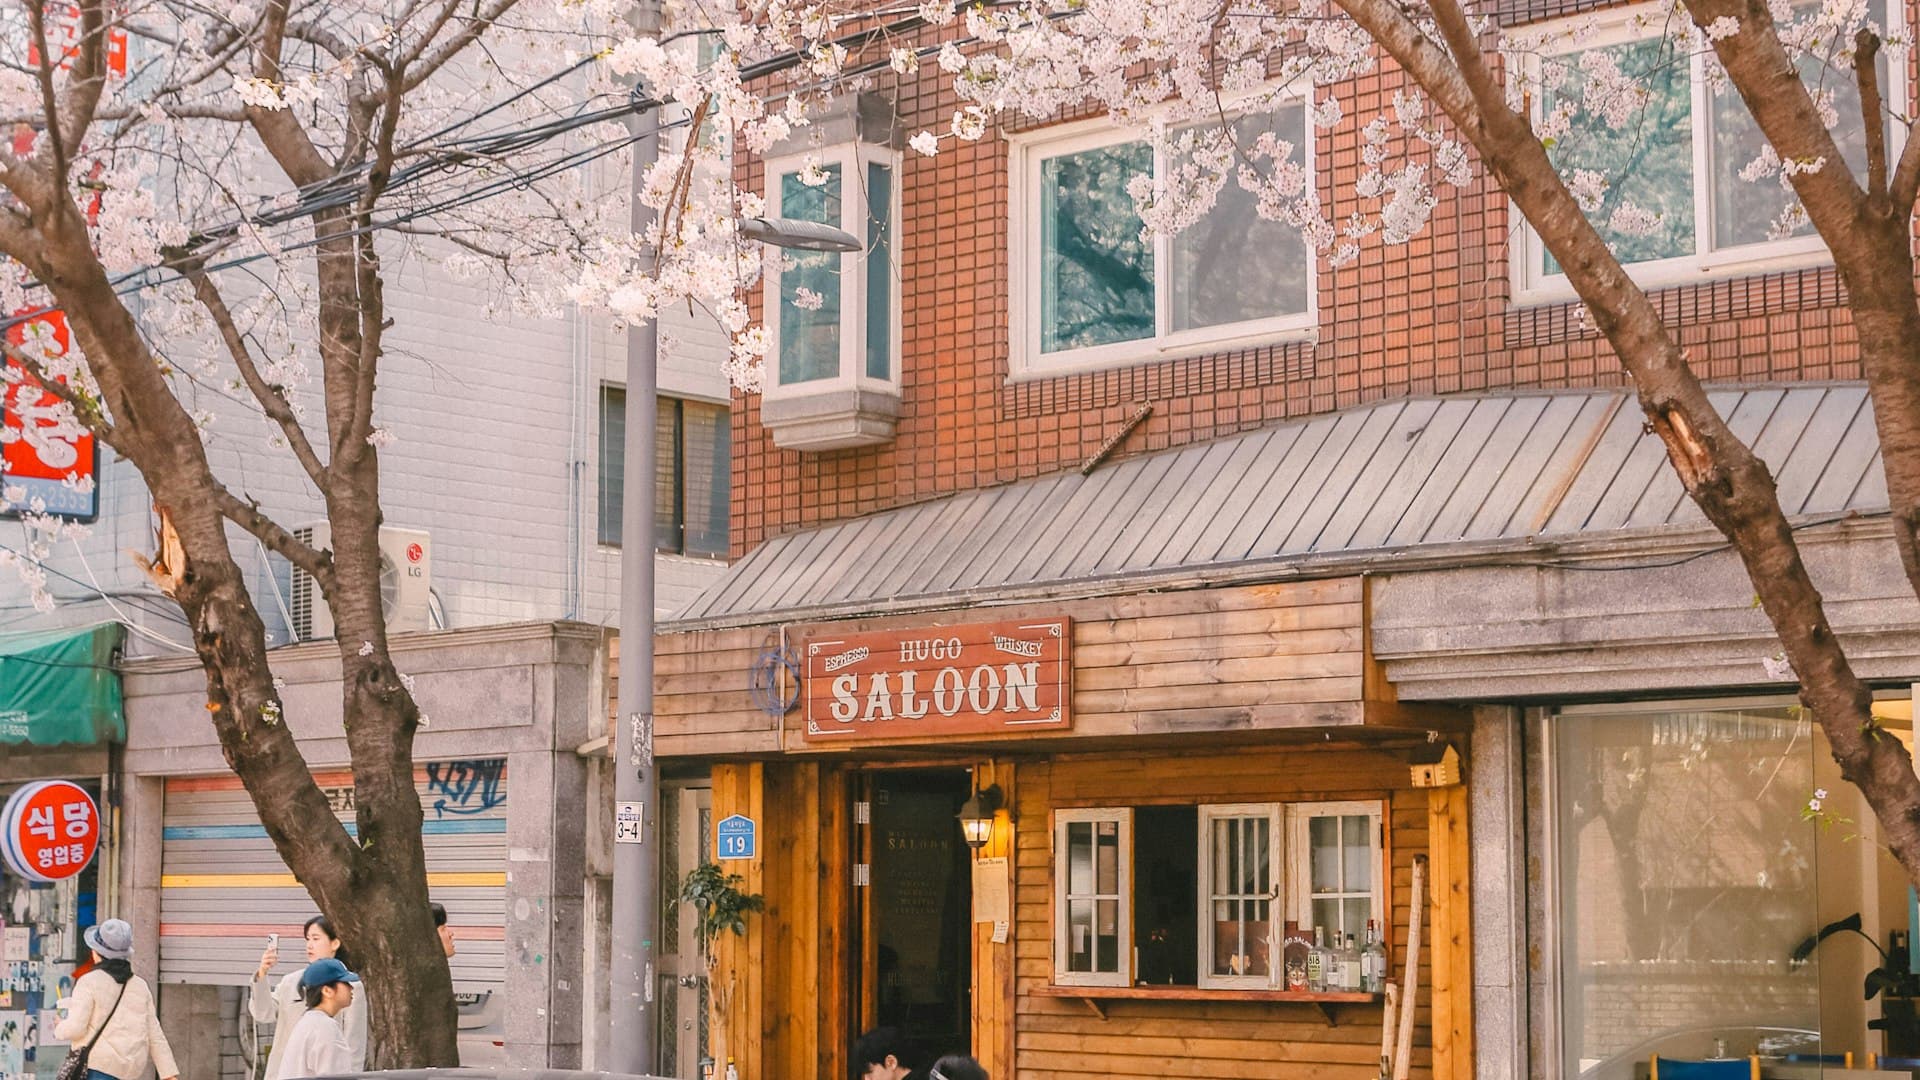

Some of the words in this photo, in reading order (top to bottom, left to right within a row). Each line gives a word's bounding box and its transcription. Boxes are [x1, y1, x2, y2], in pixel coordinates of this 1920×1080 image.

[408, 567, 422, 577] LG
[899, 637, 963, 662] HUGO
[993, 635, 1043, 655] WHISKEY
[825, 646, 870, 669] ESPRESSO
[829, 661, 1042, 723] SALOON
[26, 801, 91, 841] 식당
[617, 821, 638, 839] 3-4
[38, 843, 84, 868] 영업중
[726, 836, 746, 854] 19
